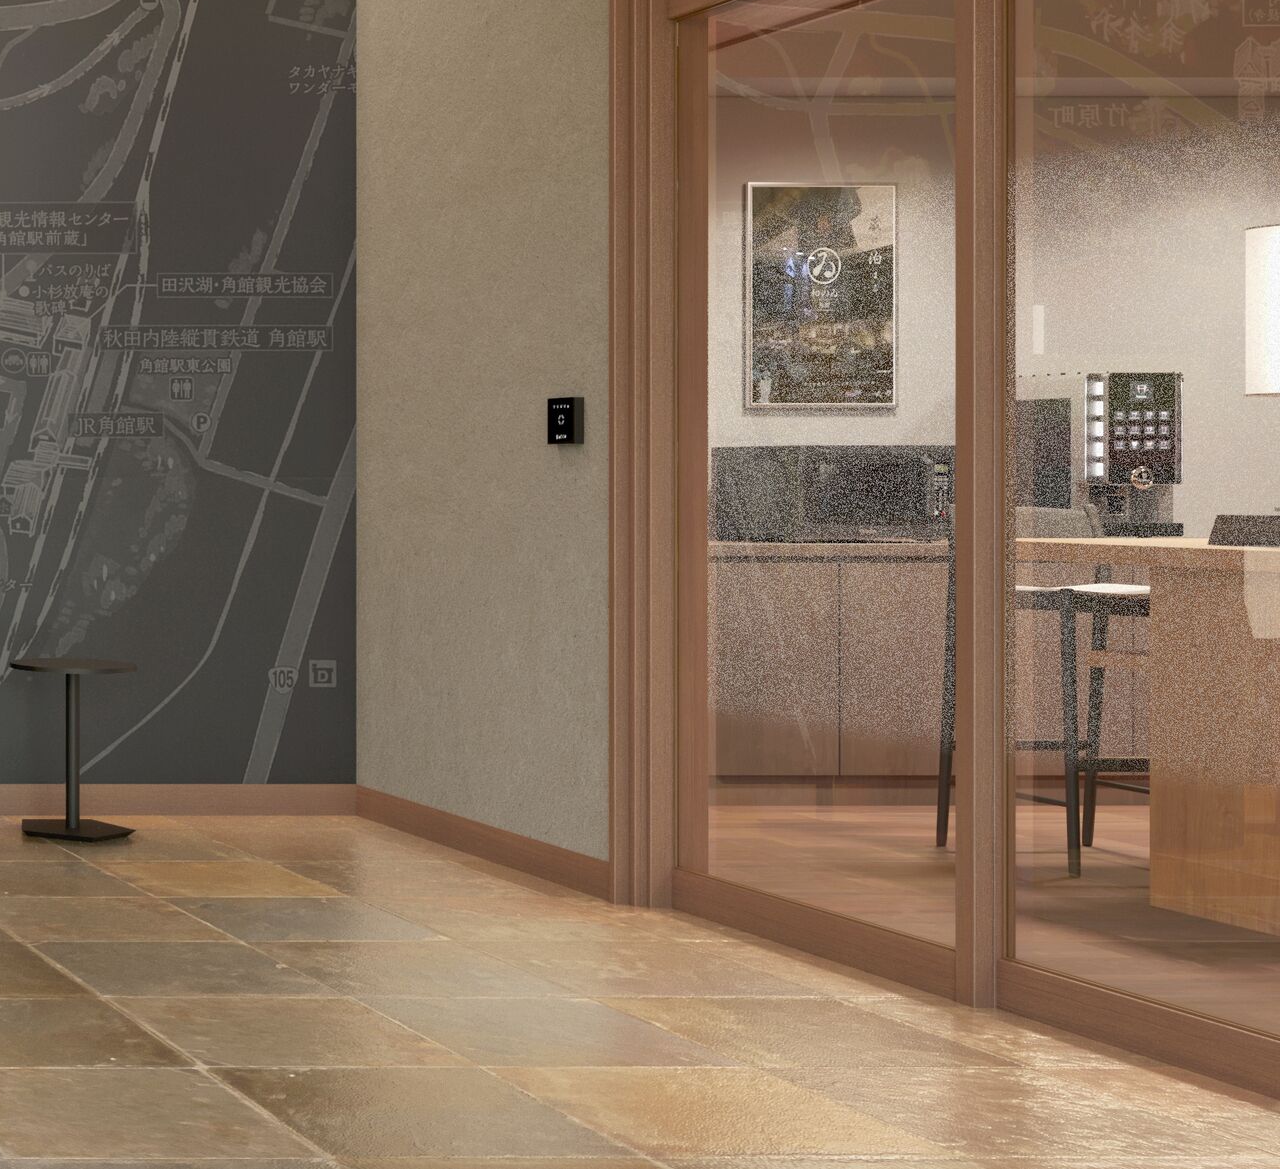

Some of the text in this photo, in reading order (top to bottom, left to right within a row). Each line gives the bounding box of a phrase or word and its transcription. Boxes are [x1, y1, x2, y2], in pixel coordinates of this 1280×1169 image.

[39, 263, 112, 278] バスのりば
[161, 276, 327, 294] 田沢湖・角館観光協会
[103, 328, 328, 349] 秋田内陸縦貫鉄道 角館駅
[139, 358, 232, 373] 角館駅東公園
[76, 417, 156, 436] JR角館駅
[272, 670, 295, 689] 105
